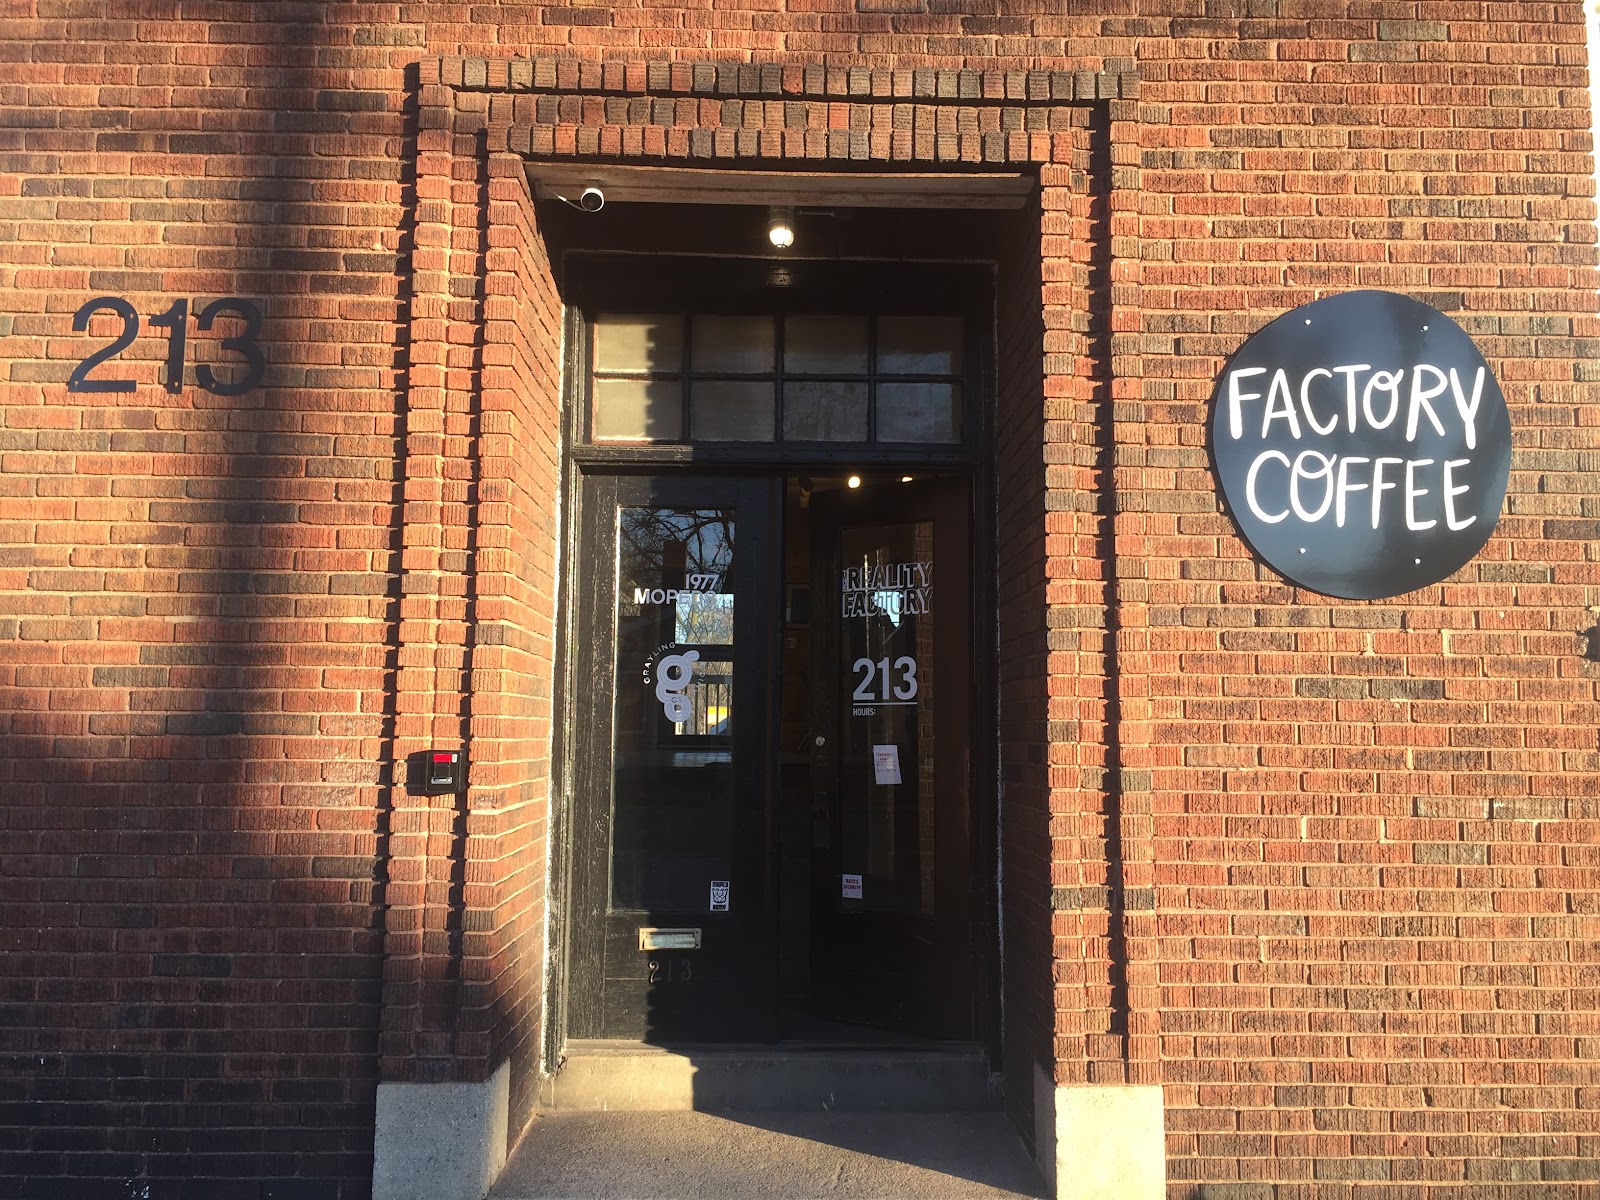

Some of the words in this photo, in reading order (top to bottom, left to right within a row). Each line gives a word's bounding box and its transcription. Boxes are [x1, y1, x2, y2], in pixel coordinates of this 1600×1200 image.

[68, 297, 265, 396] 213
[1229, 364, 1485, 450] FACTORY
[1246, 450, 1477, 531] COFFEE
[685, 573, 720, 590] 1977
[847, 562, 934, 592] REALITY
[842, 588, 934, 618] FACTORY
[643, 641, 676, 684] GRAYLING
[853, 656, 918, 701] 213
[647, 959, 693, 984] 213
